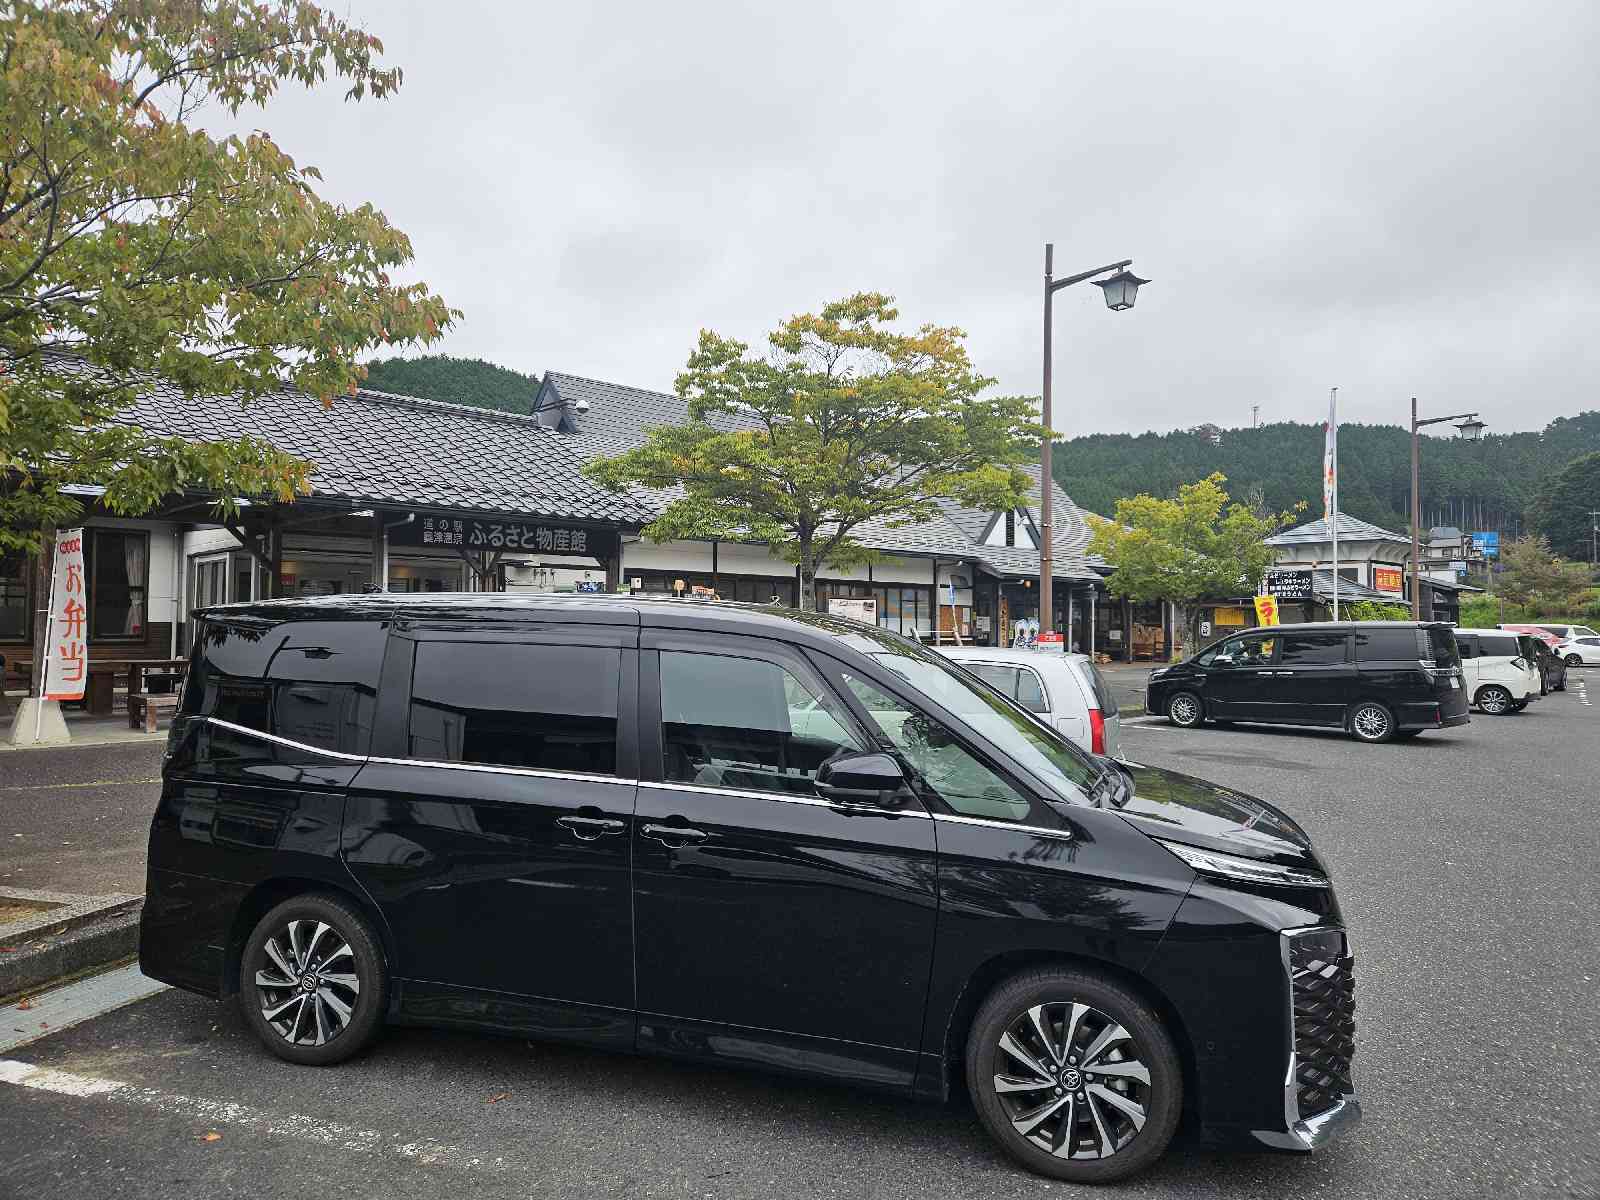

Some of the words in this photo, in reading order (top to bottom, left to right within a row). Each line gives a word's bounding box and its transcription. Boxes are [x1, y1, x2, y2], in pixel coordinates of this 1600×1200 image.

[469, 521, 587, 552] ふるさと物産館
[59, 561, 86, 682] お弁当
